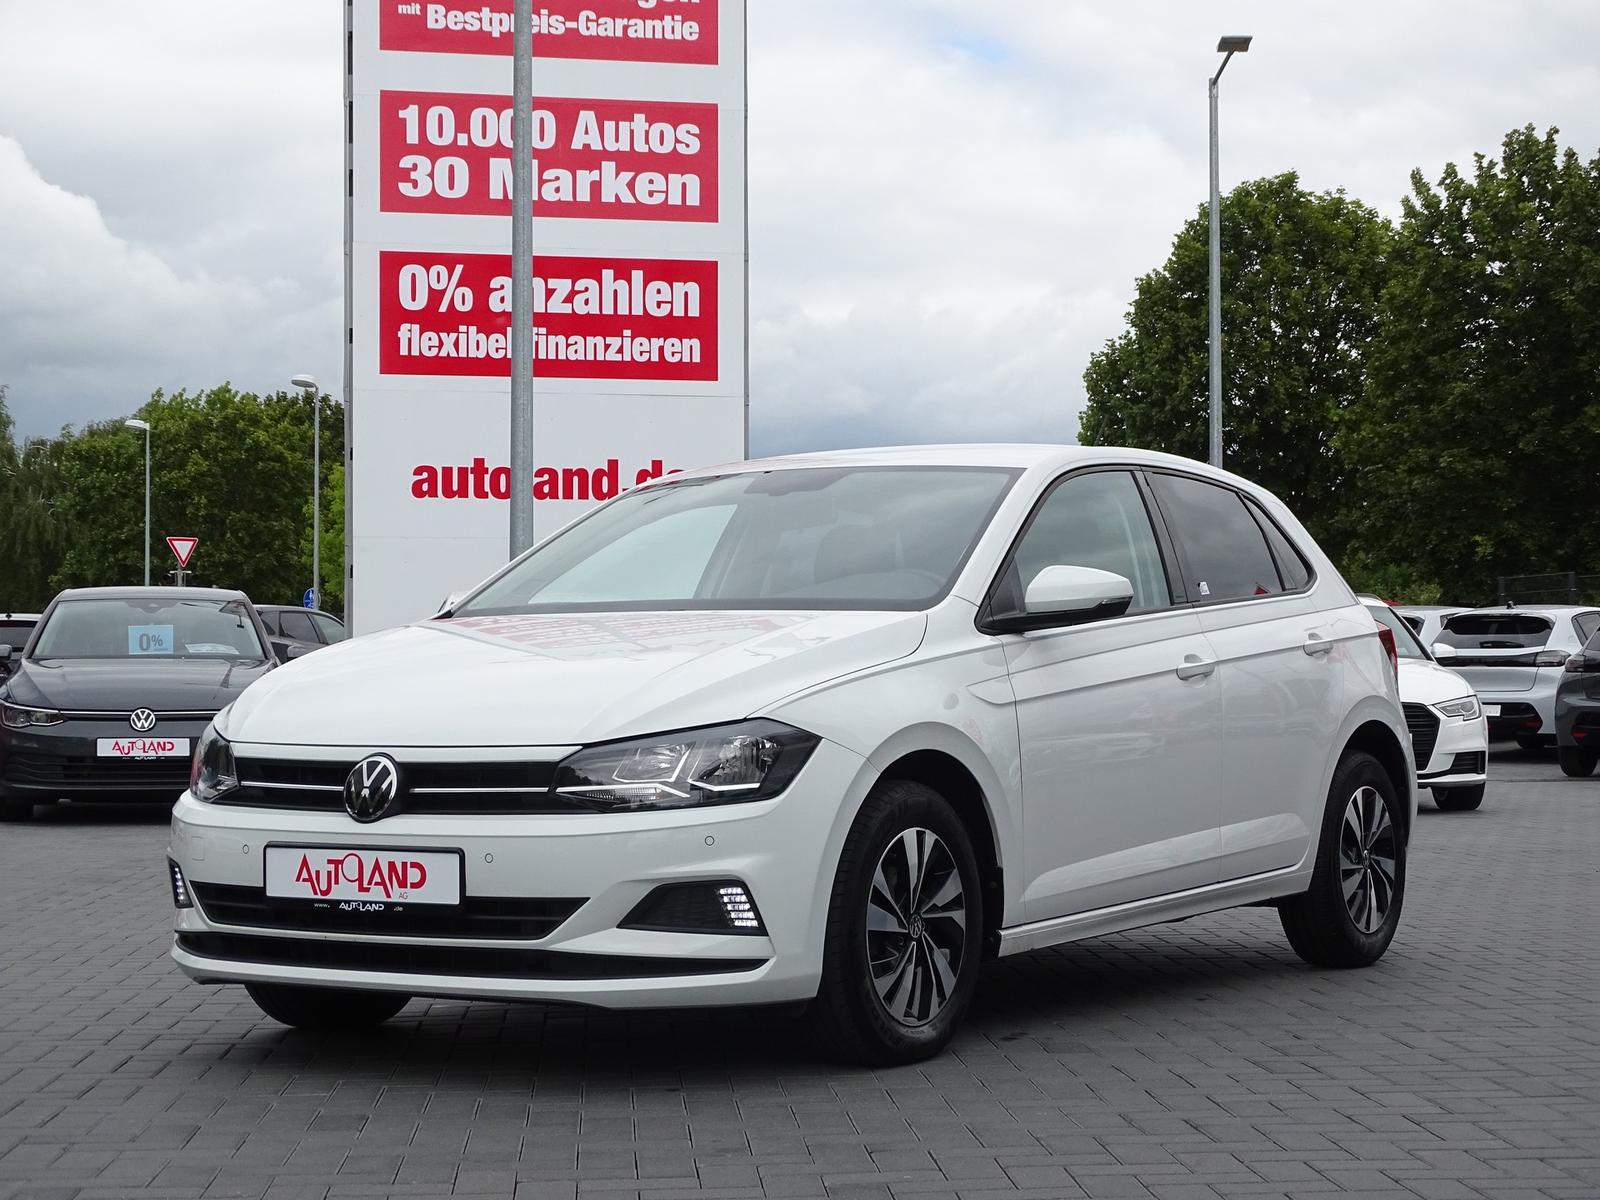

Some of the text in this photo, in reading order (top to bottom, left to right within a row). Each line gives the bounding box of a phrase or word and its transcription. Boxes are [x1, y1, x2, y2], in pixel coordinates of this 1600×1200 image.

[398, 3, 699, 41] mit Bestpis-Garantie
[571, 110, 700, 155] Autos
[398, 155, 700, 207] 30 Marken
[399, 264, 473, 313] 0%
[398, 323, 512, 360] flexibel
[139, 633, 164, 651] 0%
[295, 853, 427, 899] AUTOLAND
[399, 892, 408, 900] AG
